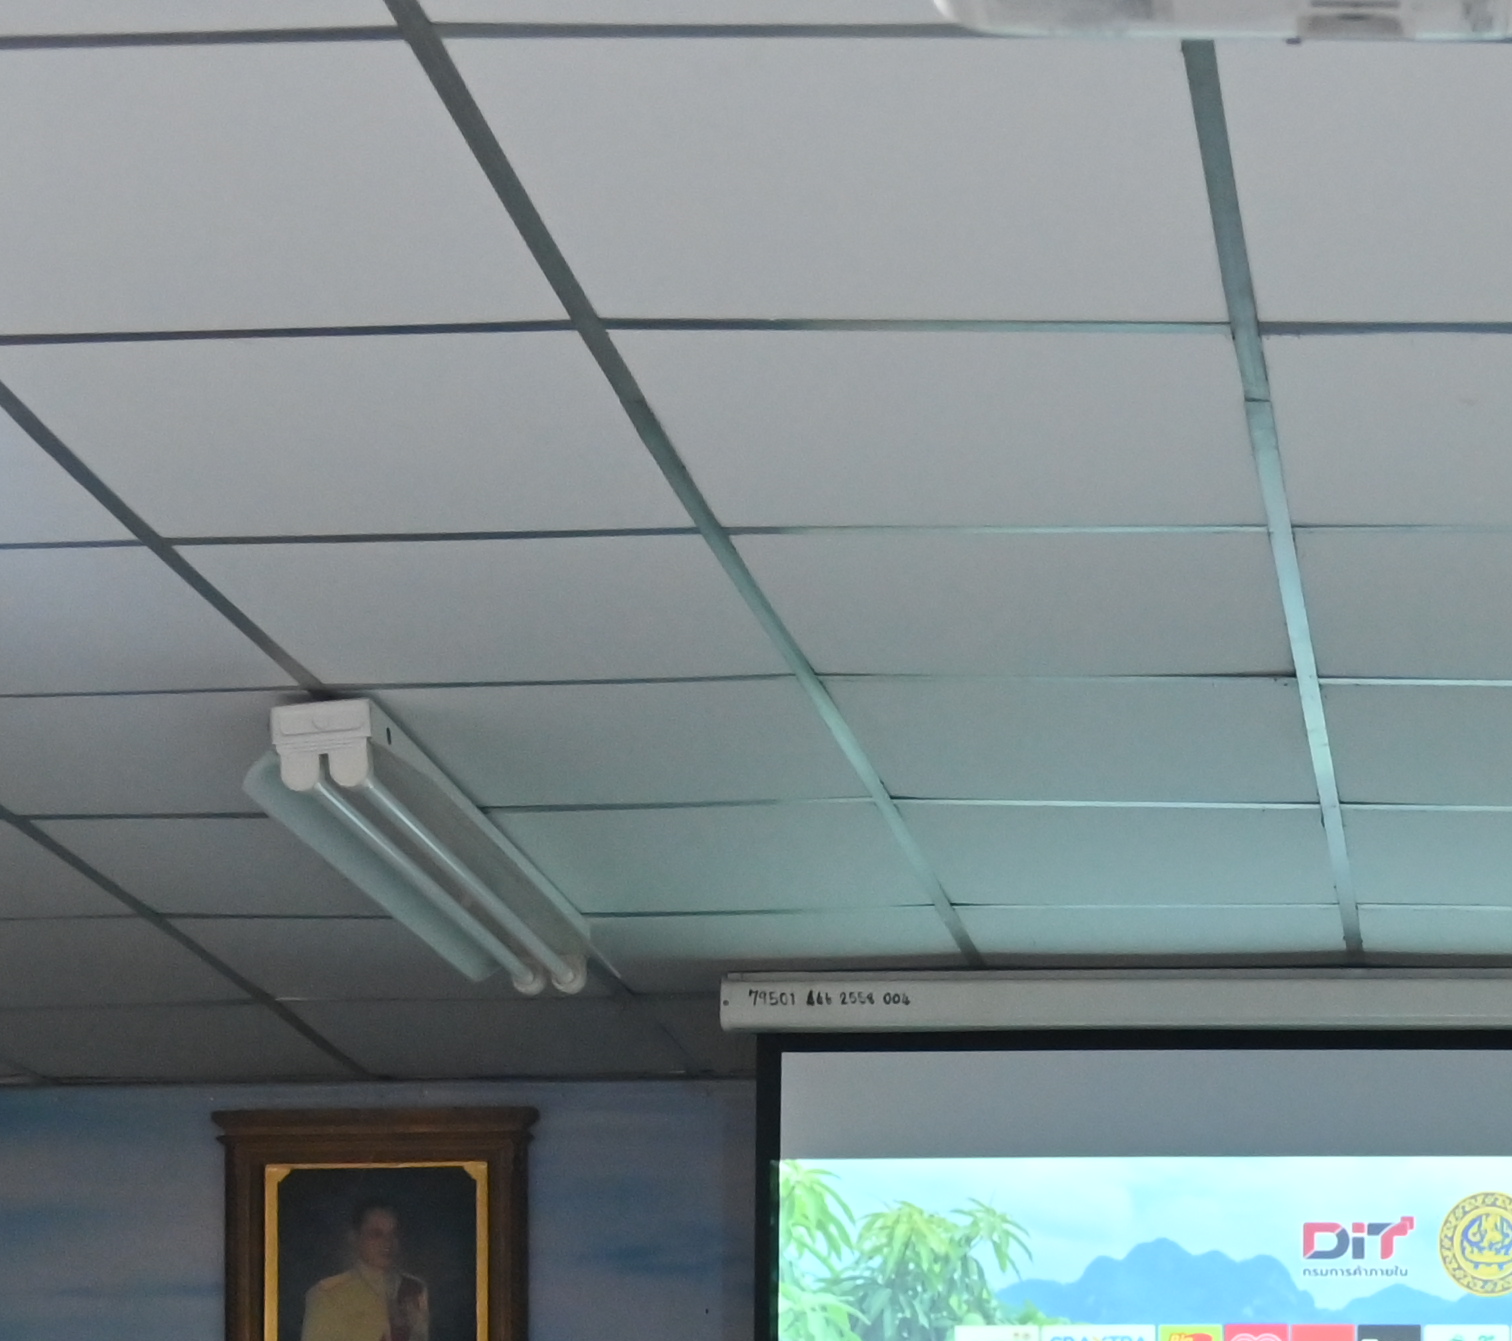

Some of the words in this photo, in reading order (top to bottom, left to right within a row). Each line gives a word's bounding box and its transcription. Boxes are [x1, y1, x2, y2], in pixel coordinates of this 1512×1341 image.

[1302, 1265, 1409, 1278] กรมการค้าภายใน
